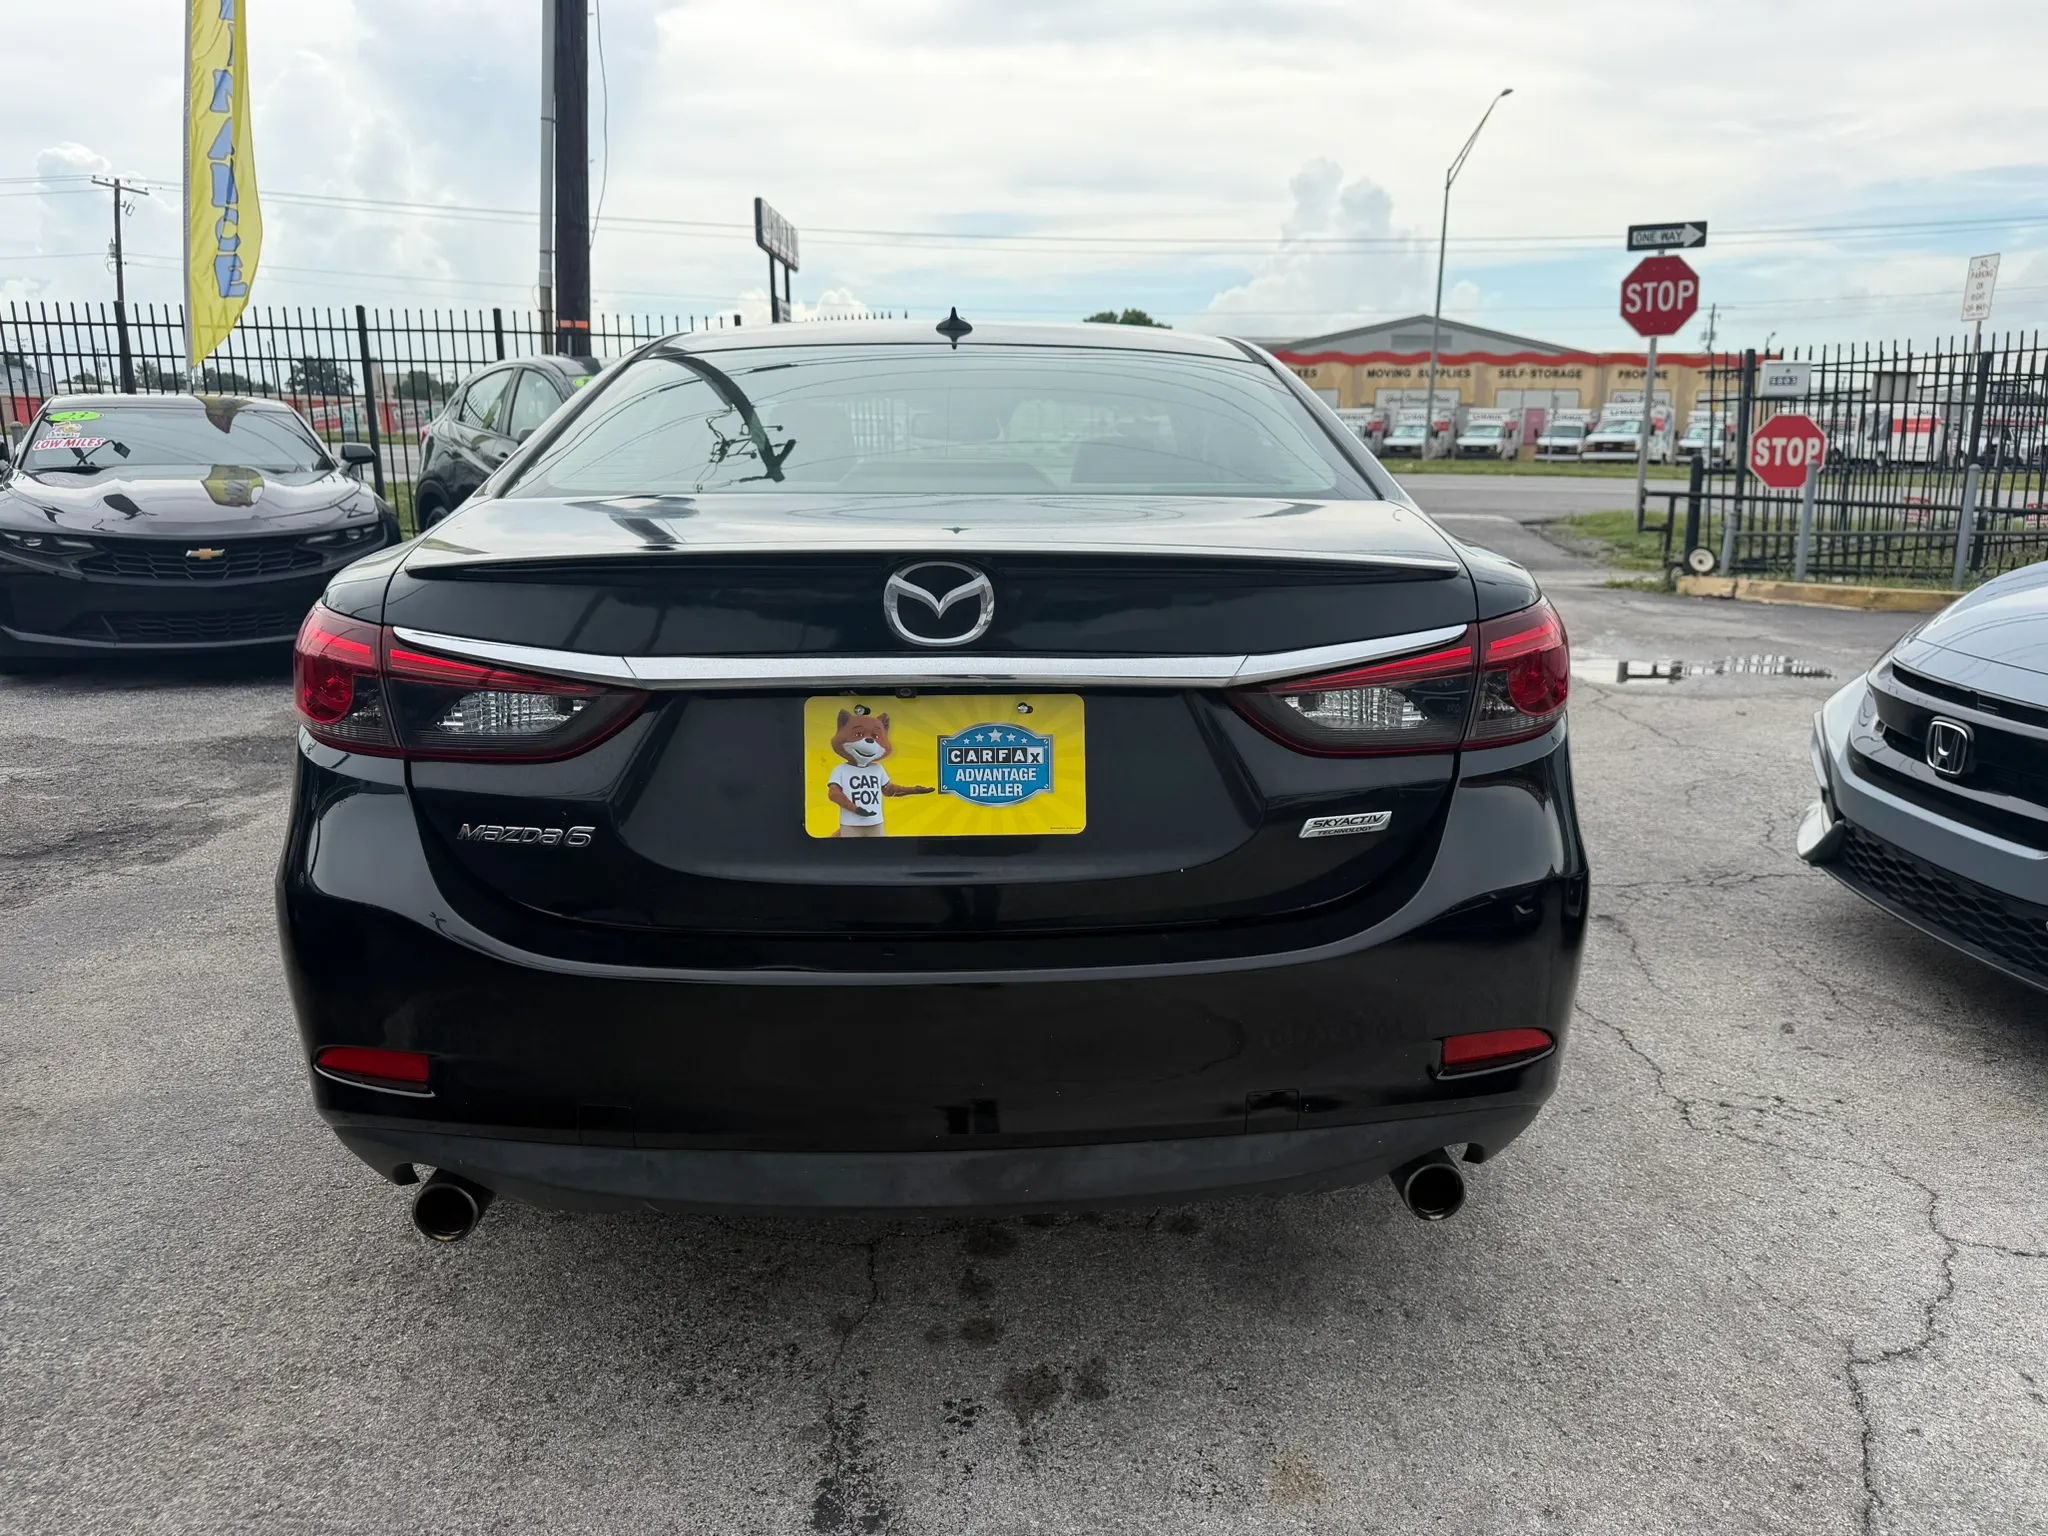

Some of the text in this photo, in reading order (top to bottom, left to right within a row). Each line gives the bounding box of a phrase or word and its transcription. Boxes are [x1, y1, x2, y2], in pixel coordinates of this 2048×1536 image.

[1635, 231, 1682, 243] ONE WAY
[1625, 280, 1695, 314] STOP
[1367, 368, 1411, 379] MOVING
[1498, 368, 1583, 380] SELF-STORAGE
[1618, 369, 1668, 380] PROPNE
[34, 438, 102, 450] LOW MILES
[1755, 436, 1821, 467] STOP
[949, 748, 1043, 764] CARFAX
[955, 767, 1037, 782] ADVANTAGE
[849, 775, 879, 789] CAR
[969, 783, 1023, 797] DEALER
[851, 790, 879, 805] FOX
[1311, 814, 1384, 828] SKYACTIV
[1319, 825, 1374, 835] TECHNOLOGY
